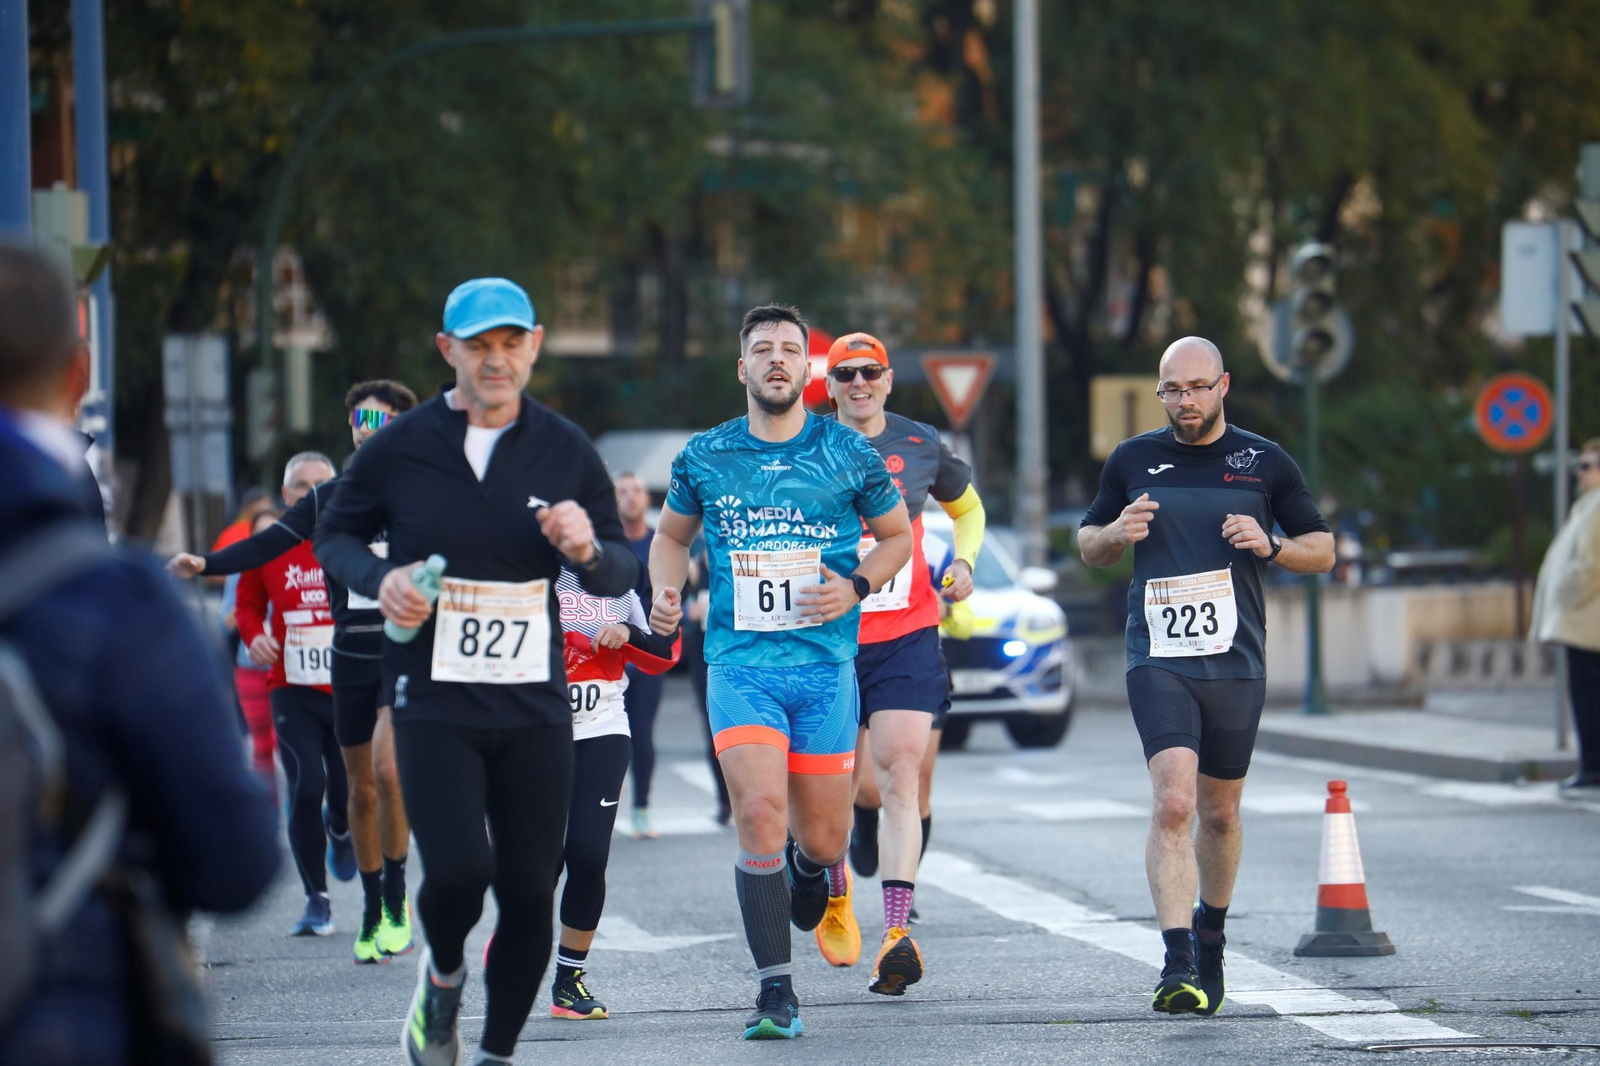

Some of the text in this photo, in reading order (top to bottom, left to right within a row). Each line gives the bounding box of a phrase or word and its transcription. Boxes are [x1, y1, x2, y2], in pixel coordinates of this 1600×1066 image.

[747, 507, 805, 522] MEDIA
[718, 519, 748, 539] 38
[749, 521, 838, 539] MARATÓN
[807, 541, 832, 549] 2024
[736, 553, 759, 577] XLI
[788, 552, 806, 560] POPULAR
[1199, 575, 1216, 583] POPULAR
[301, 589, 326, 603] UCO
[758, 579, 791, 612] 61
[1149, 581, 1170, 605] XLI
[1162, 602, 1218, 638] 223
[459, 617, 529, 659] 827
[297, 648, 332, 671] 190
[568, 684, 600, 713] 90
[745, 858, 780, 869] HANKER
